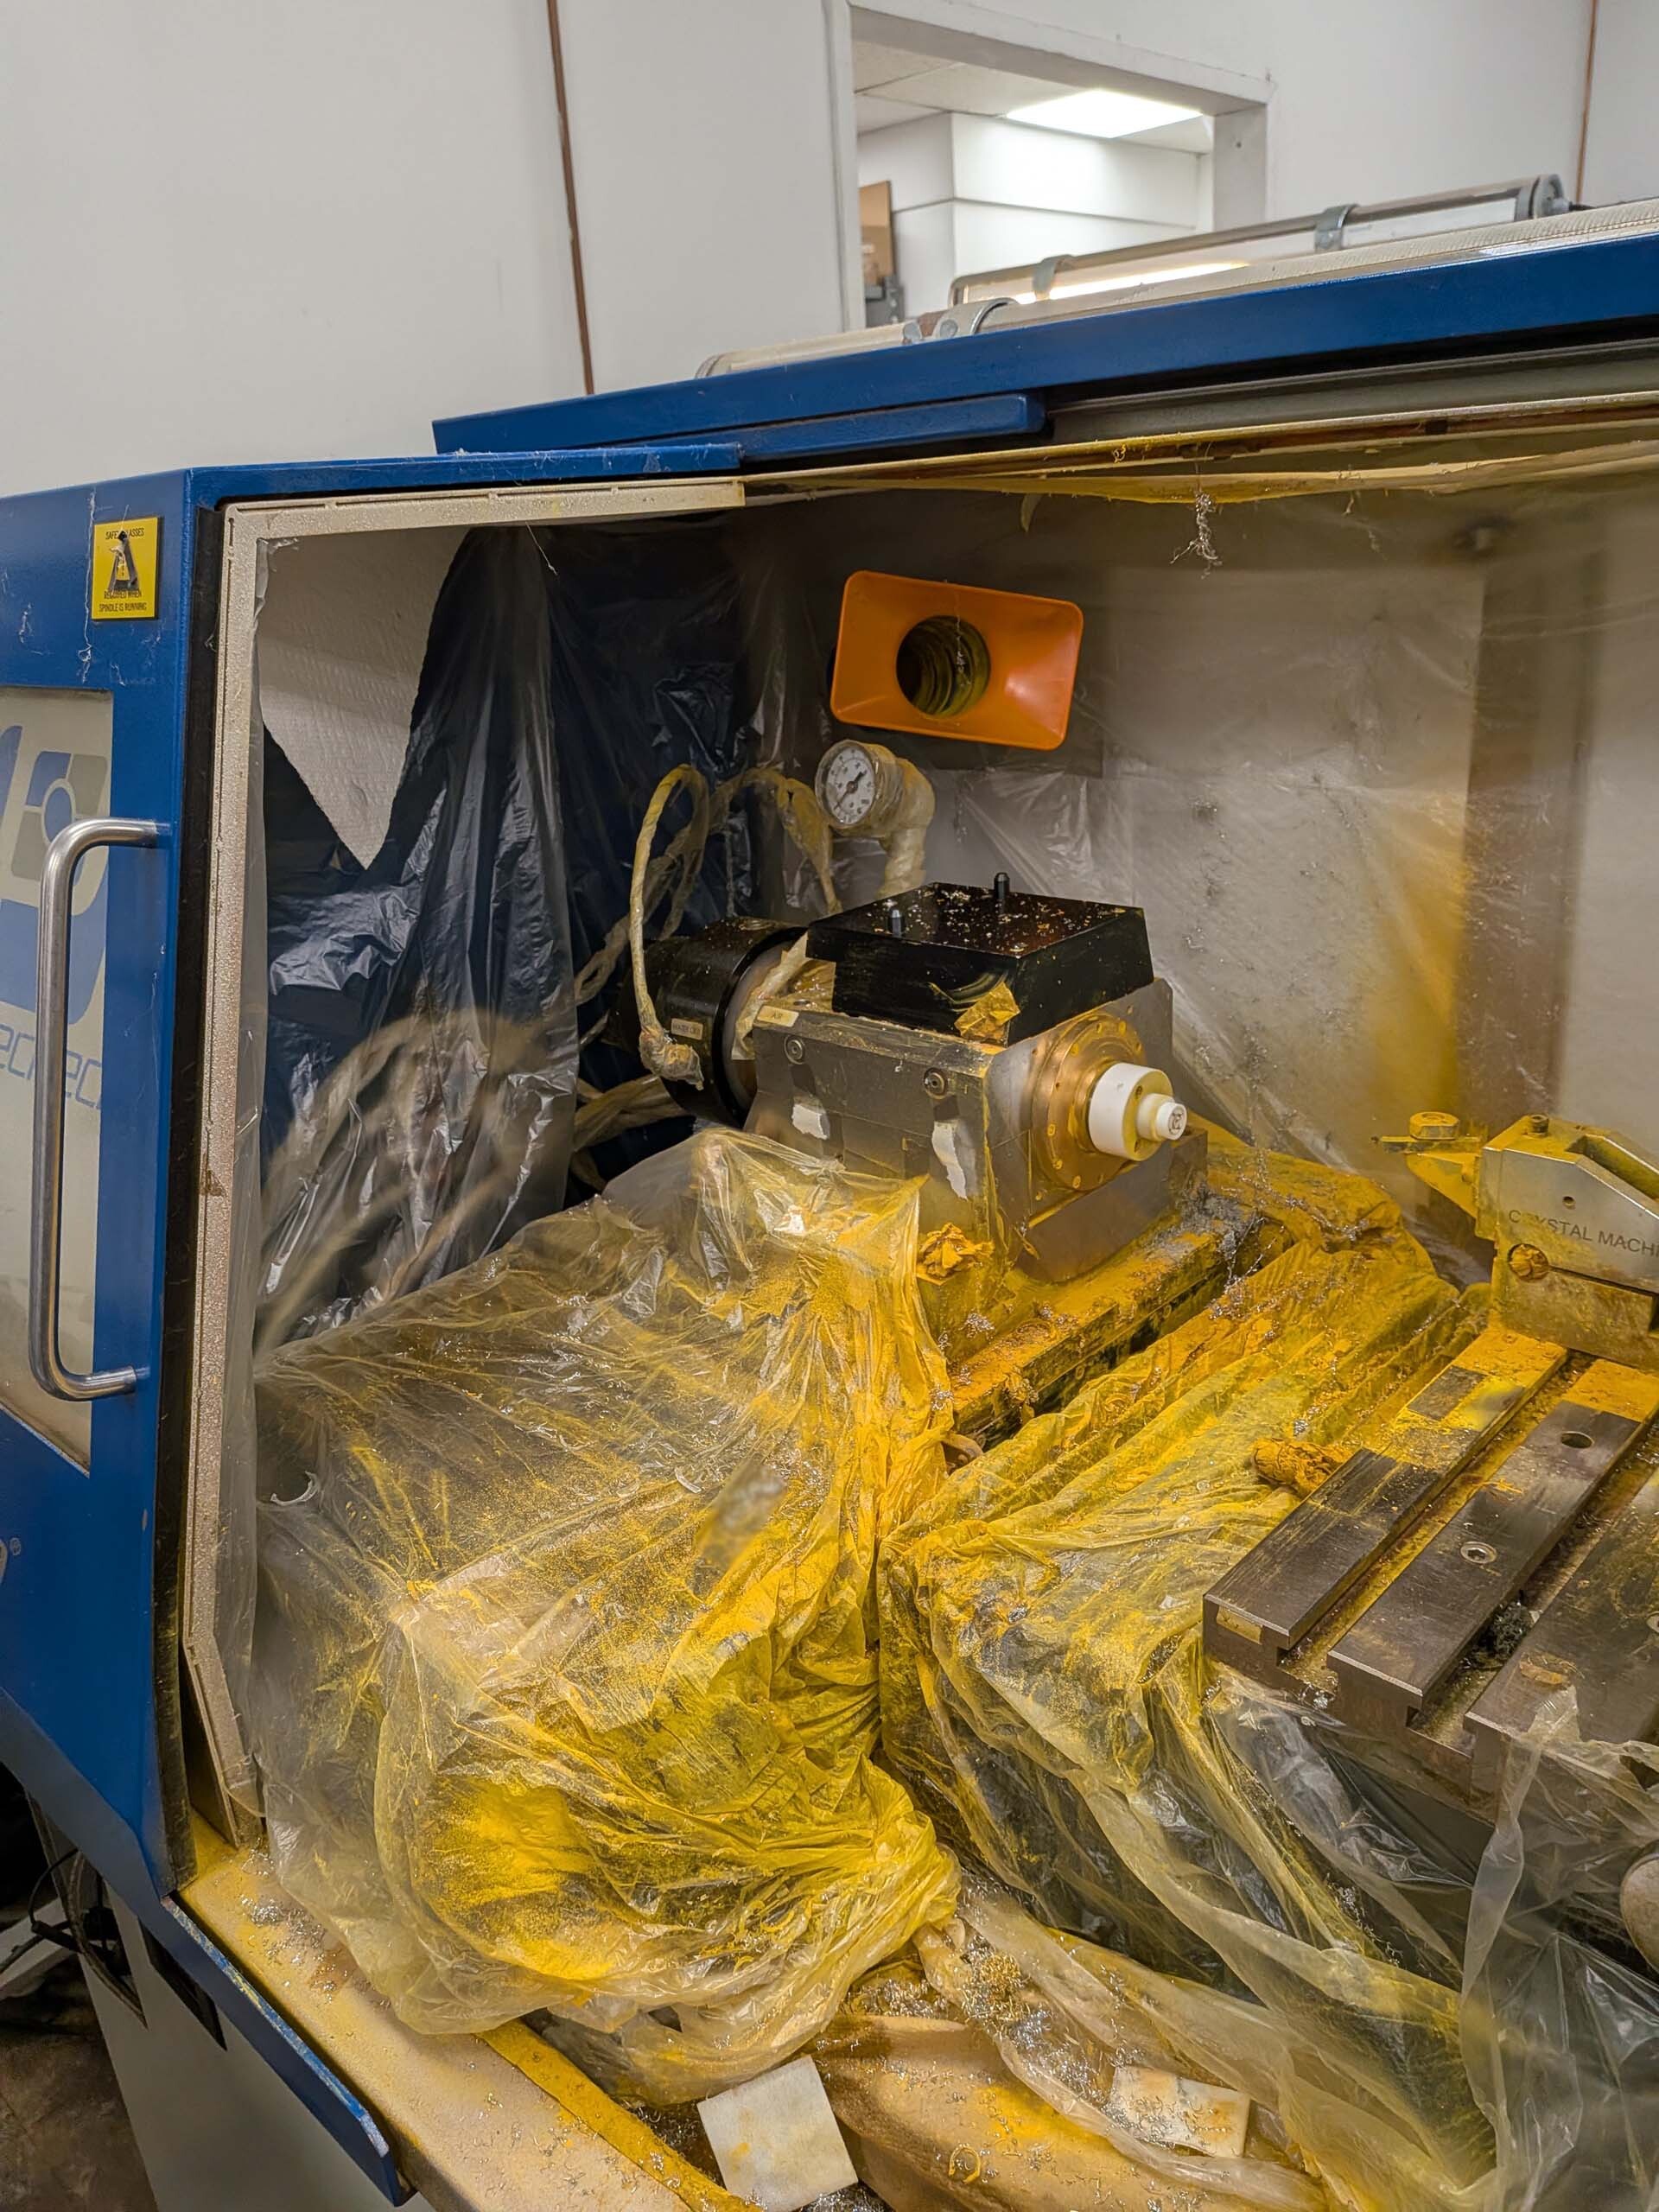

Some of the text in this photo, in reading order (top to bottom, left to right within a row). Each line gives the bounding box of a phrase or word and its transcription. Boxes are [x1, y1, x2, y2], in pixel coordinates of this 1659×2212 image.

[99, 602, 118, 613] SPINDLE
[124, 601, 147, 611] RUNNING
[1509, 1210, 1592, 1242] CYSTAL
